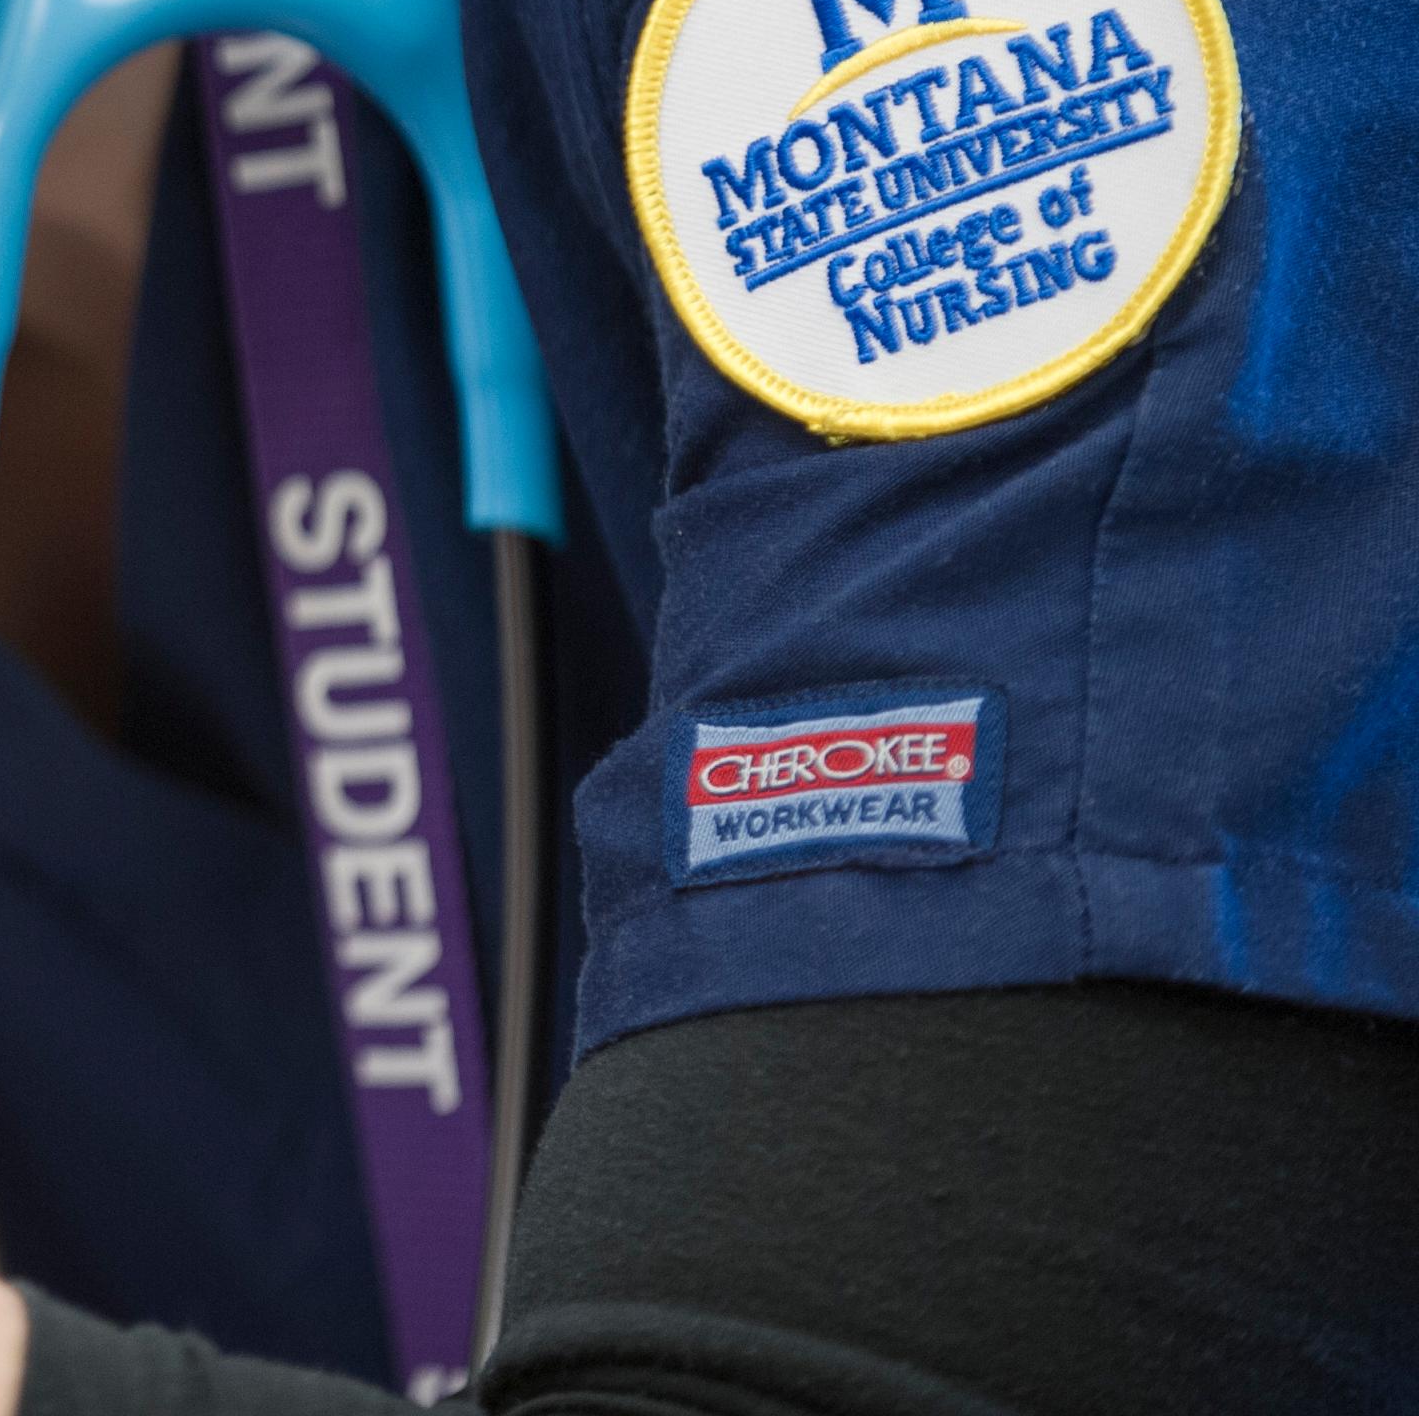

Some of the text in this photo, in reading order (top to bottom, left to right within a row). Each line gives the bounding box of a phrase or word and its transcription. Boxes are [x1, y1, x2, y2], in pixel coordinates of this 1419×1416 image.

[701, 9, 1152, 230] MONTANA
[725, 65, 1174, 276] STATE UNIVERSITY
[828, 165, 1094, 308] College of
[844, 229, 1117, 364] NURSING
[268, 467, 463, 1116] STUDENT
[713, 791, 940, 842] WORKWEAR
